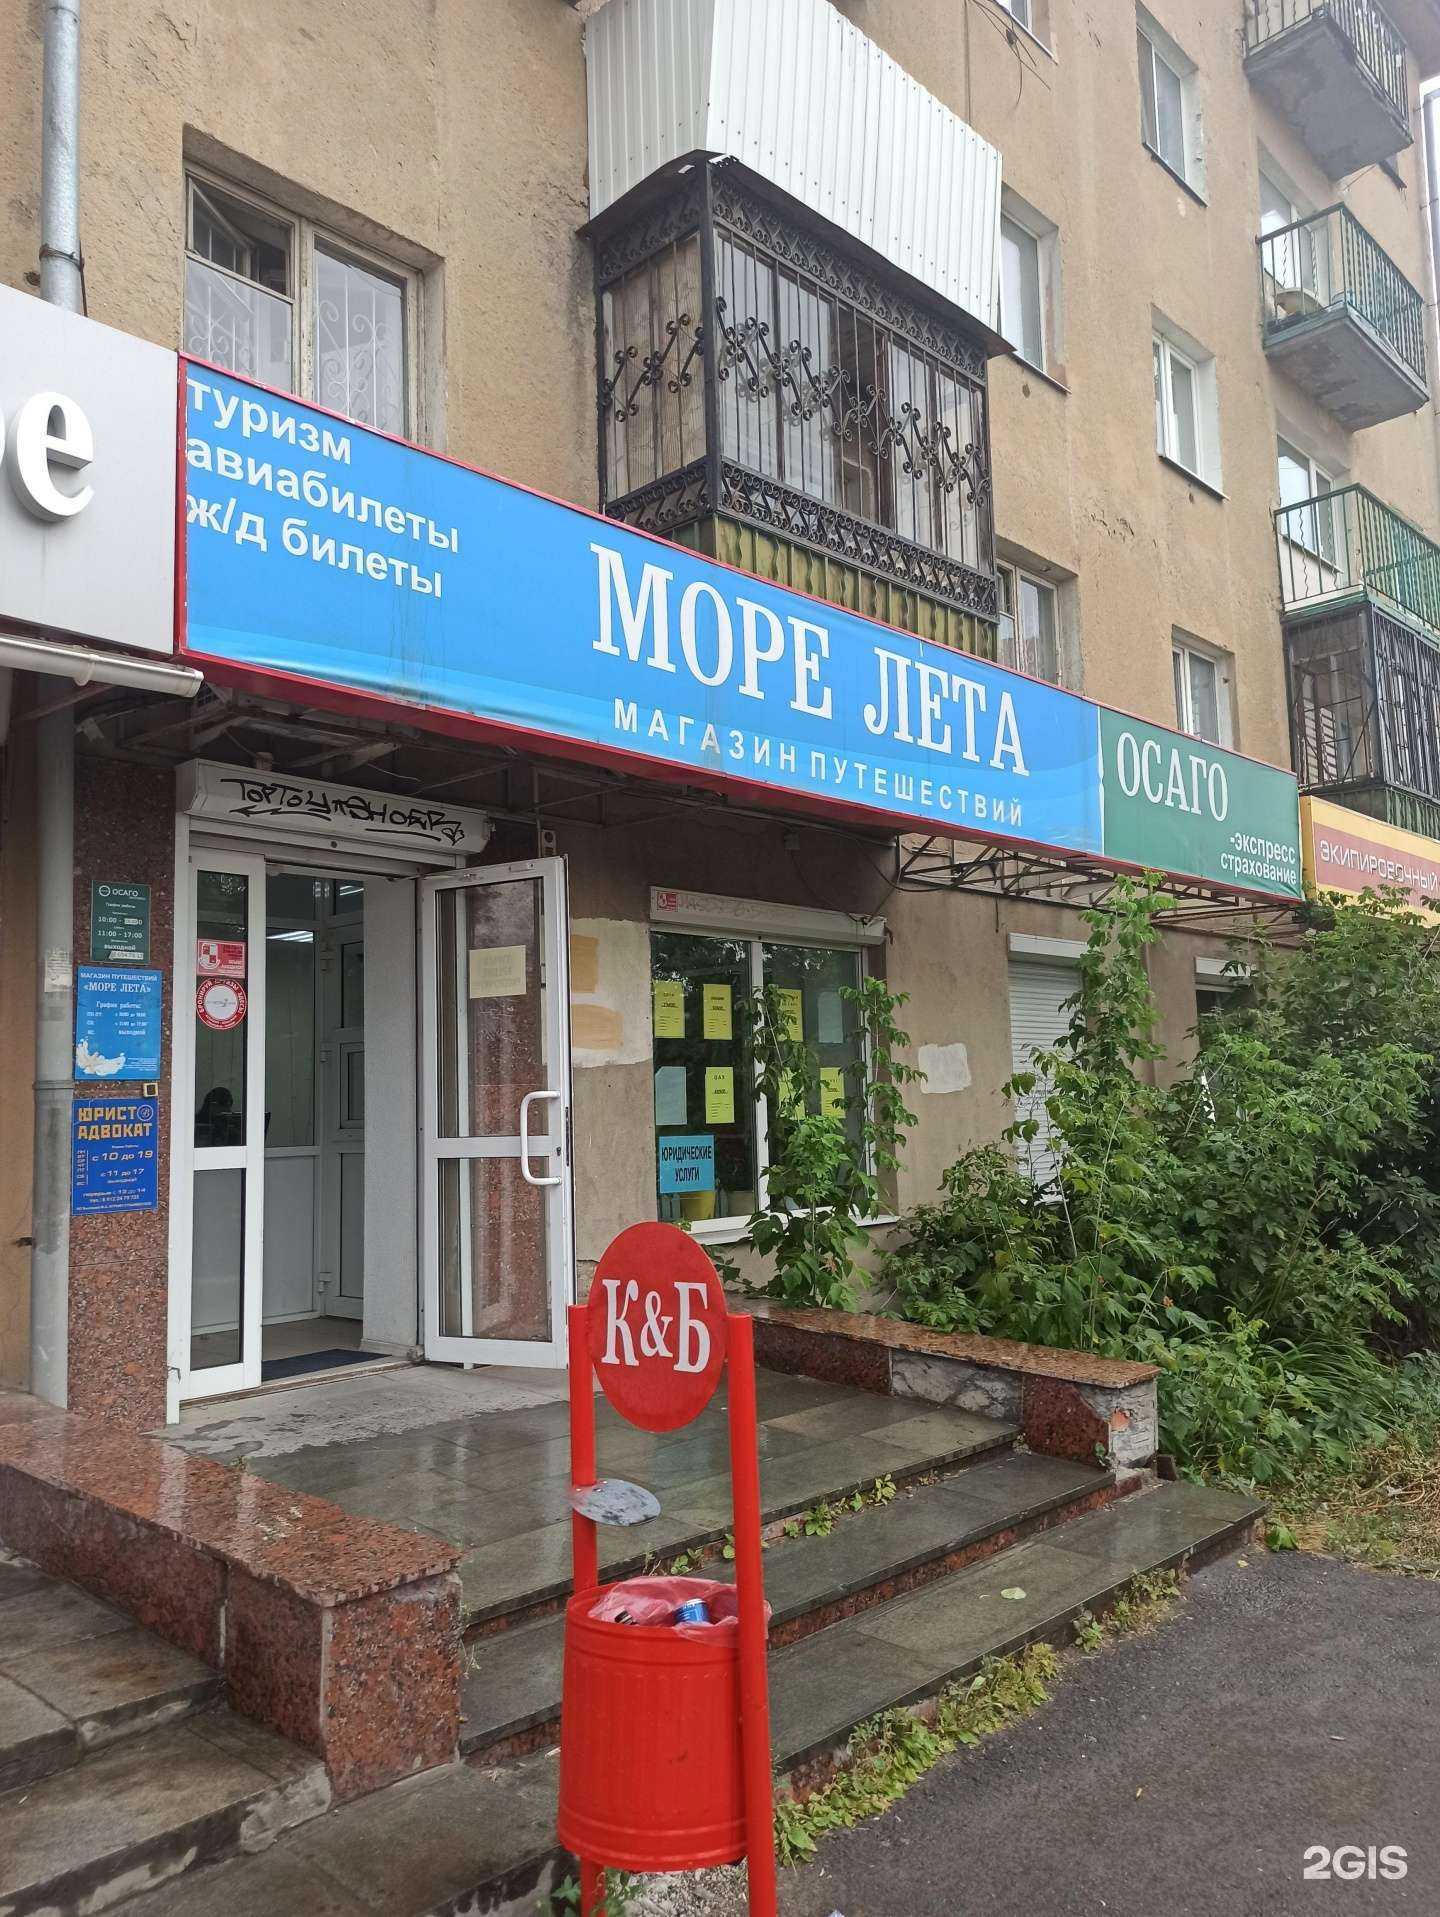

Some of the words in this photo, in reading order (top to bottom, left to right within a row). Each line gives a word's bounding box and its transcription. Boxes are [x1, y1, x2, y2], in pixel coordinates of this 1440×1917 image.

[187, 378, 351, 465] туризм
[187, 438, 459, 553] авиабилеты
[187, 494, 268, 553] ж/д
[282, 517, 442, 599] билеты
[590, 543, 832, 720] МОРЕ
[863, 647, 1030, 777] ЛЕТА
[614, 698, 796, 773] МАГАЗИН
[811, 751, 1022, 828] ПУТЕШЕСТВИЙ
[1117, 732, 1228, 822] ОСАГО
[1220, 851, 1298, 886] страхование
[1320, 840, 1438, 891] ЭКИПИРОВОЧНЫЙ
[112, 888, 139, 897] ОСАГО
[124, 931, 143, 939] 17:00
[80, 972, 111, 980] МАГАЗИН
[111, 973, 158, 982] ПУТЕШЕСТВИЙ
[83, 982, 117, 992] «МОРЕ
[120, 983, 151, 993] ЛЕТА»
[78, 1106, 137, 1122] ЮРИСТ
[78, 1123, 152, 1140] АДВОКАТ
[102, 1152, 119, 1161] 10
[138, 1150, 153, 1159] 19
[661, 1146, 712, 1163] ЮРИДИЧЕСКИЕ
[675, 1166, 700, 1184] УСЛУГИ
[601, 1279, 711, 1373] К&Б
